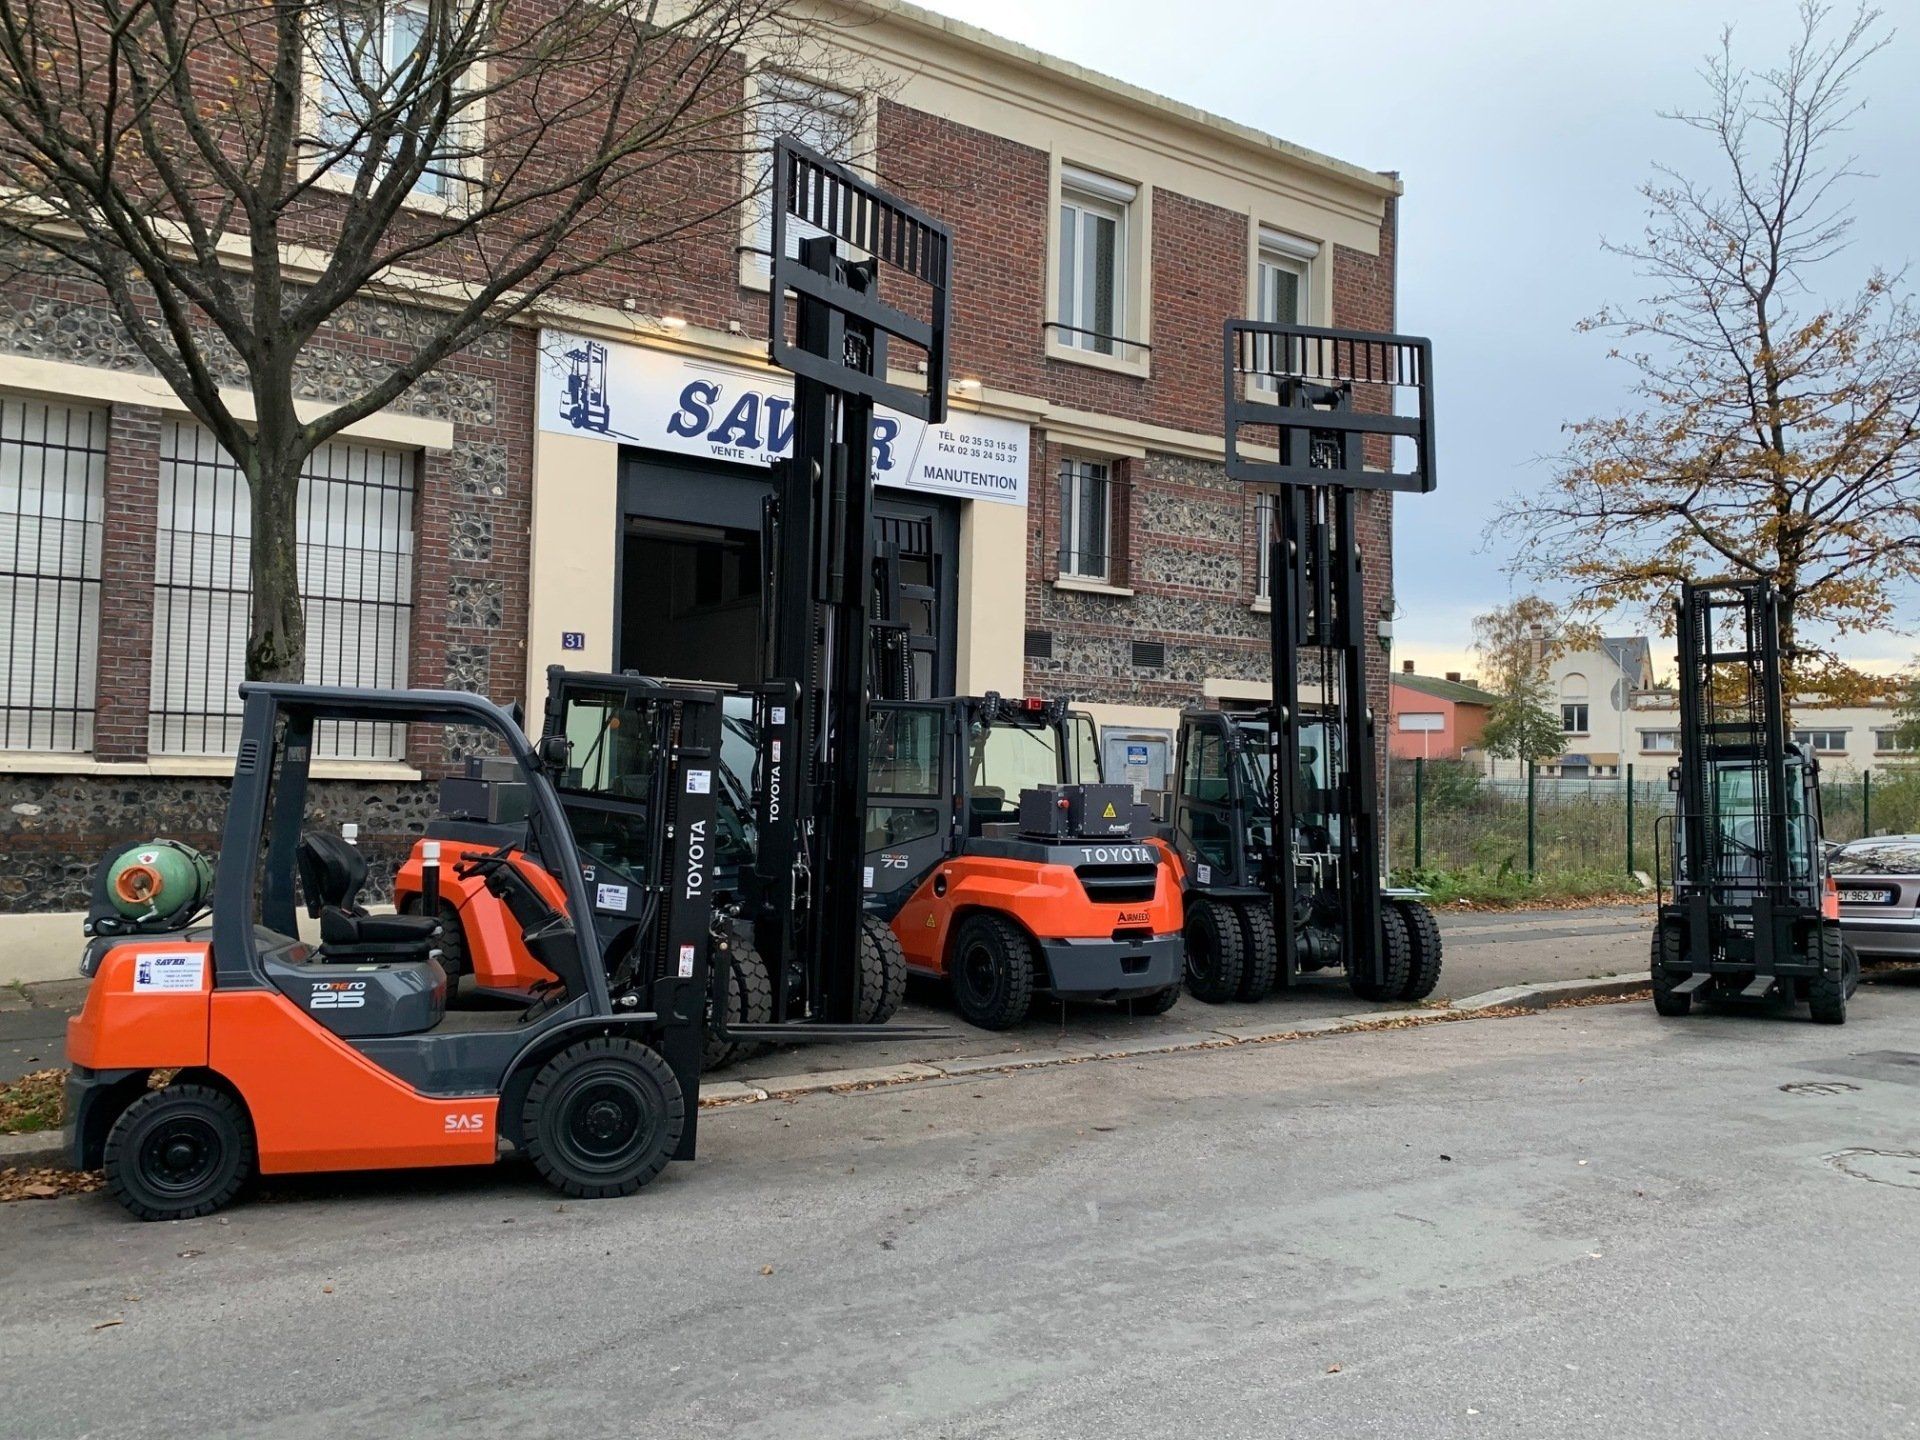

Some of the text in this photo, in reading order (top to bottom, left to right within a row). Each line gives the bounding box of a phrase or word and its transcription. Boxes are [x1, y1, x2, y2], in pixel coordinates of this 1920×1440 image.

[667, 379, 901, 471] SAVR
[711, 445, 745, 459] VENTE
[960, 434, 970, 444] 02
[971, 436, 982, 446] 35
[984, 438, 994, 448] 53
[997, 441, 1006, 450] 15
[1008, 443, 1018, 452] 45
[938, 443, 1017, 464] FAX 02 35 24 53 37
[924, 465, 1017, 491] MANUTENTION
[565, 633, 582, 648] 31
[769, 765, 781, 823] TOYOTA
[686, 819, 706, 900] TOYOTA
[881, 859, 908, 869] 70
[1081, 847, 1151, 863] TOYOTA
[1851, 891, 1869, 901] 962
[1872, 891, 1884, 901] XP
[310, 991, 365, 1009] 25
[445, 1113, 484, 1129] SAS
